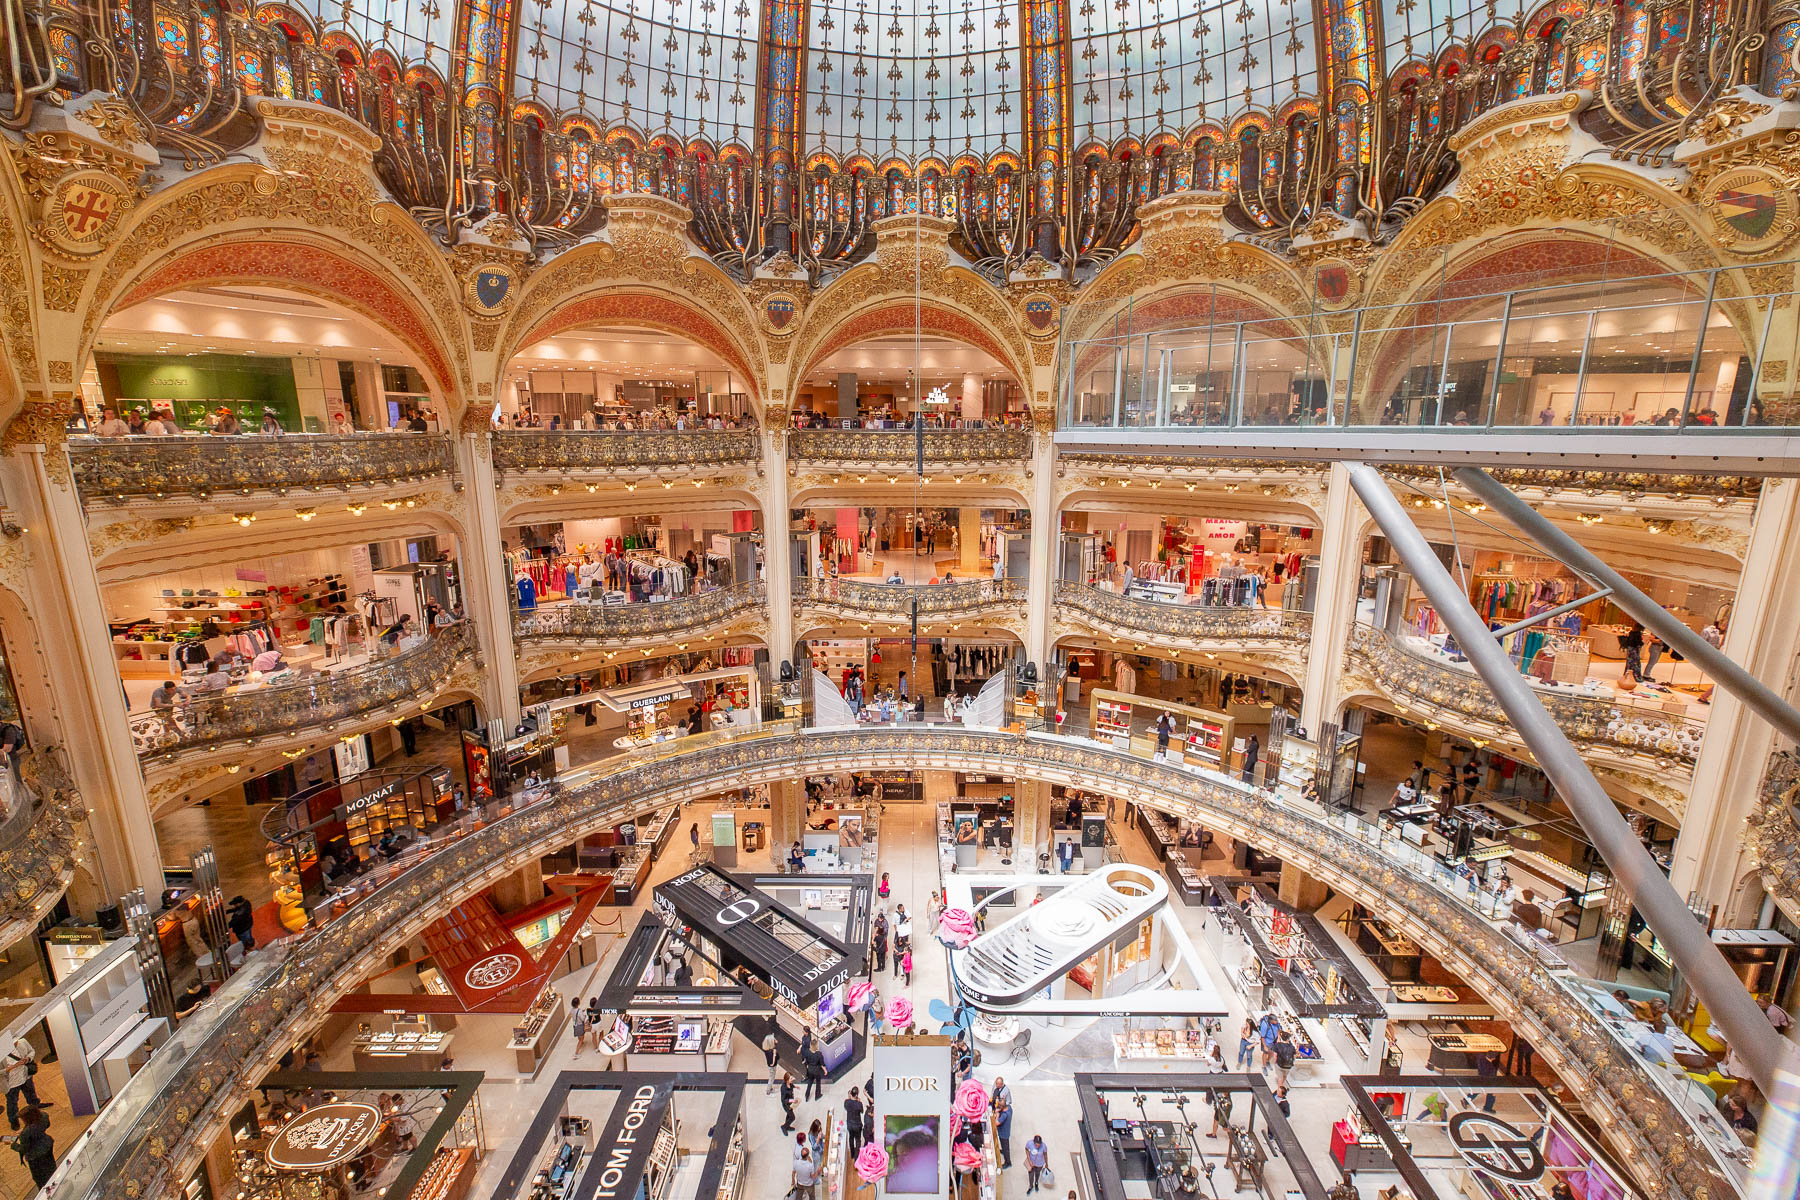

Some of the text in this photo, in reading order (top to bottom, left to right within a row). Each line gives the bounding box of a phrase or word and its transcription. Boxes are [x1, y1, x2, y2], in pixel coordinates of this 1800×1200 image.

[632, 694, 671, 708] GUERLAIN
[346, 784, 394, 813] MOYNAT
[671, 868, 706, 887] DIOR
[655, 891, 677, 917] DIOR
[803, 957, 842, 982] DIOR
[770, 975, 799, 1007] DIOR
[817, 969, 849, 1001] DIOR
[884, 1076, 940, 1091] DIOR
[327, 1111, 370, 1158] DIPTYQUE
[592, 1085, 656, 1200] TOM FORD
